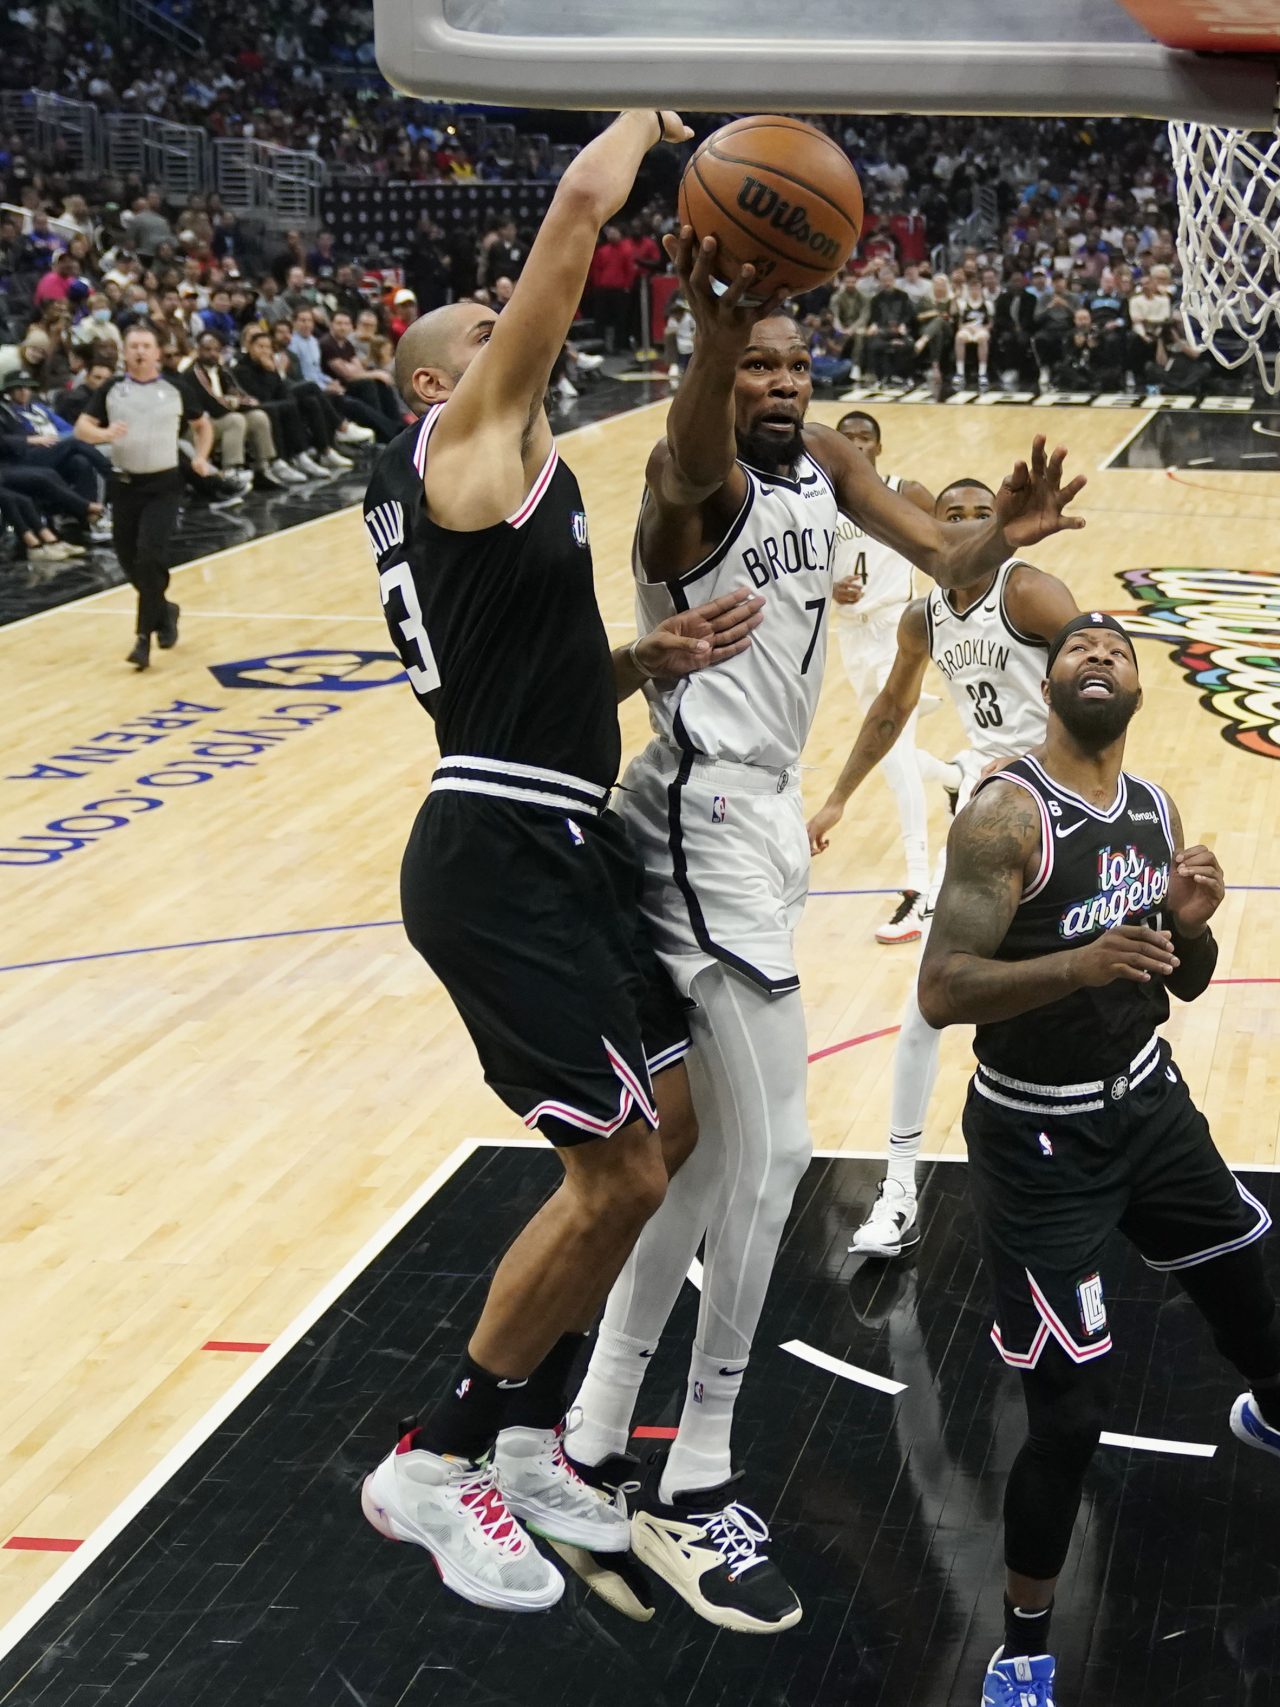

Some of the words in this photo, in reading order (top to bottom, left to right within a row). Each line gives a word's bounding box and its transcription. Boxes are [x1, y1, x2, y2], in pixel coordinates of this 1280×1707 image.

[737, 175, 842, 260] Wilson
[803, 487, 828, 500] Webull
[853, 551, 869, 586] 4
[801, 597, 826, 676] 7
[936, 638, 1010, 681] BROOKLYN
[965, 681, 1003, 729] 33
[4, 699, 228, 781] ARENA
[1047, 800, 1063, 817] 6
[1127, 809, 1160, 824] honey
[1099, 848, 1145, 892] los
[1062, 865, 1170, 936] angeles
